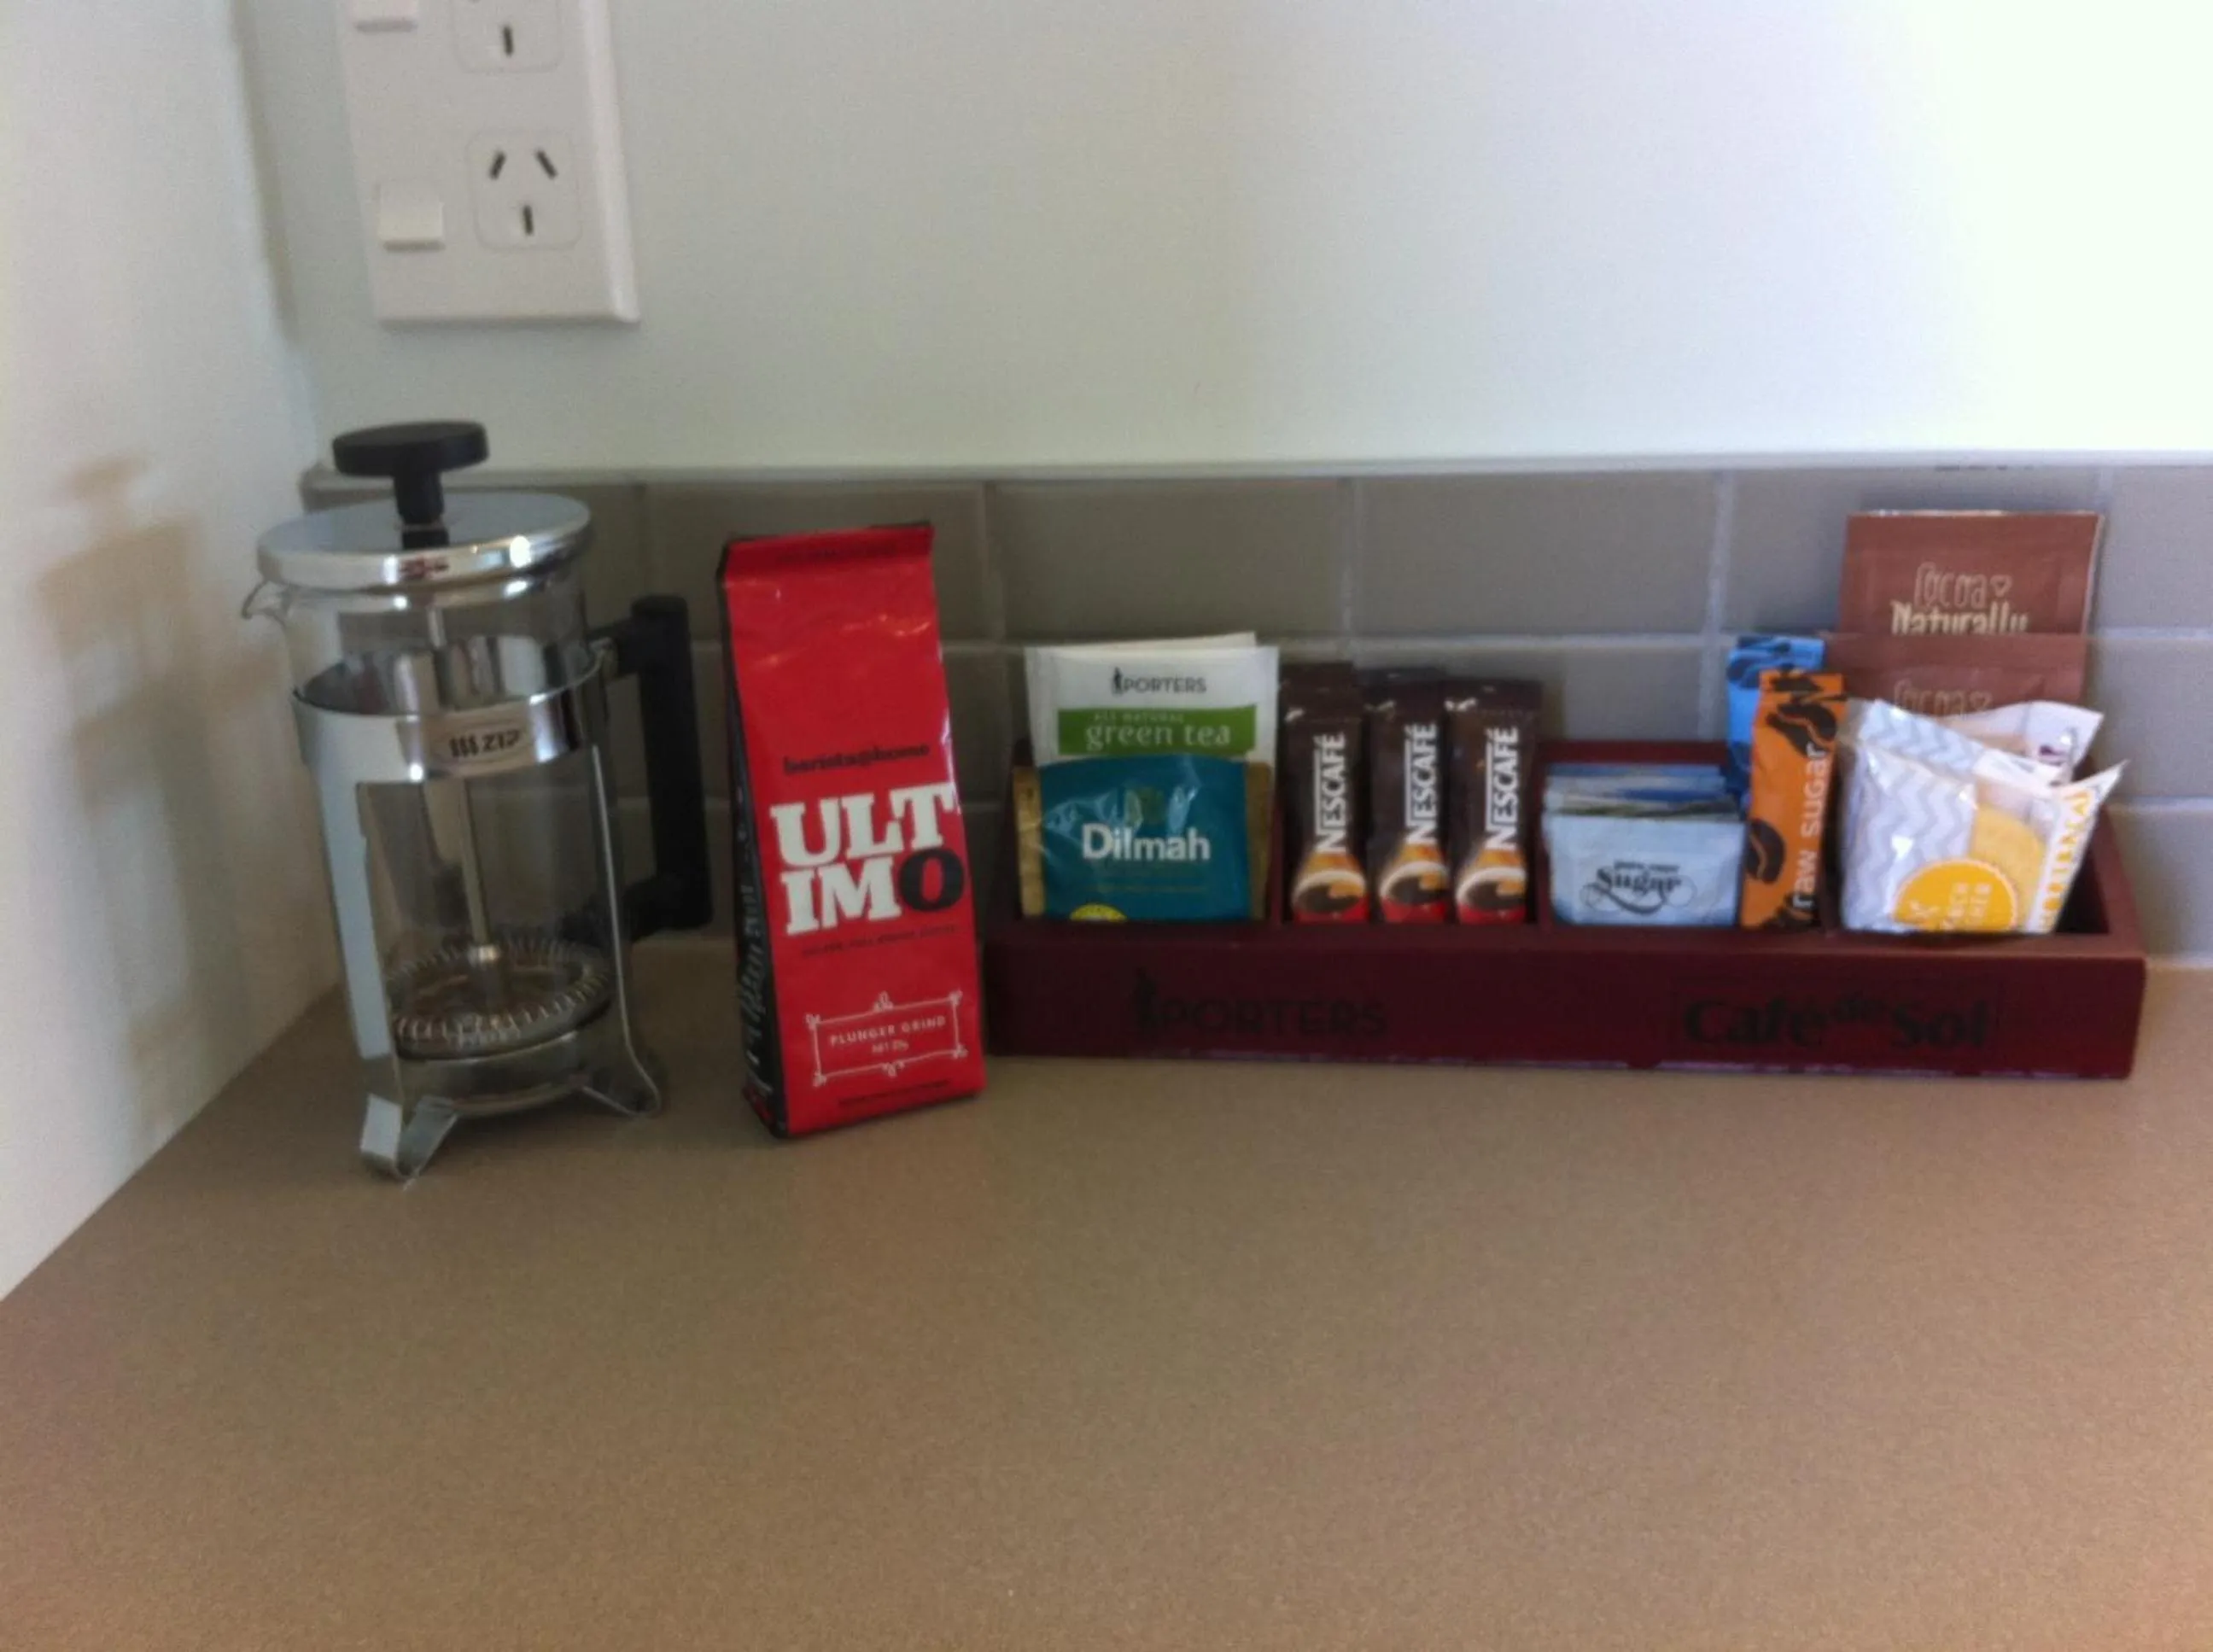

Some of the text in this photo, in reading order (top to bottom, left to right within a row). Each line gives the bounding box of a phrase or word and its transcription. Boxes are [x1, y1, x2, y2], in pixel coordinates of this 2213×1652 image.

[1123, 675, 1208, 695] PORTERS
[1085, 722, 1232, 751] green tea
[769, 780, 961, 868] ULT
[1081, 821, 1212, 862] Dilmah
[780, 847, 965, 936] IMO
[1792, 849, 1818, 909] raw
[1889, 997, 1989, 1048] Sol
